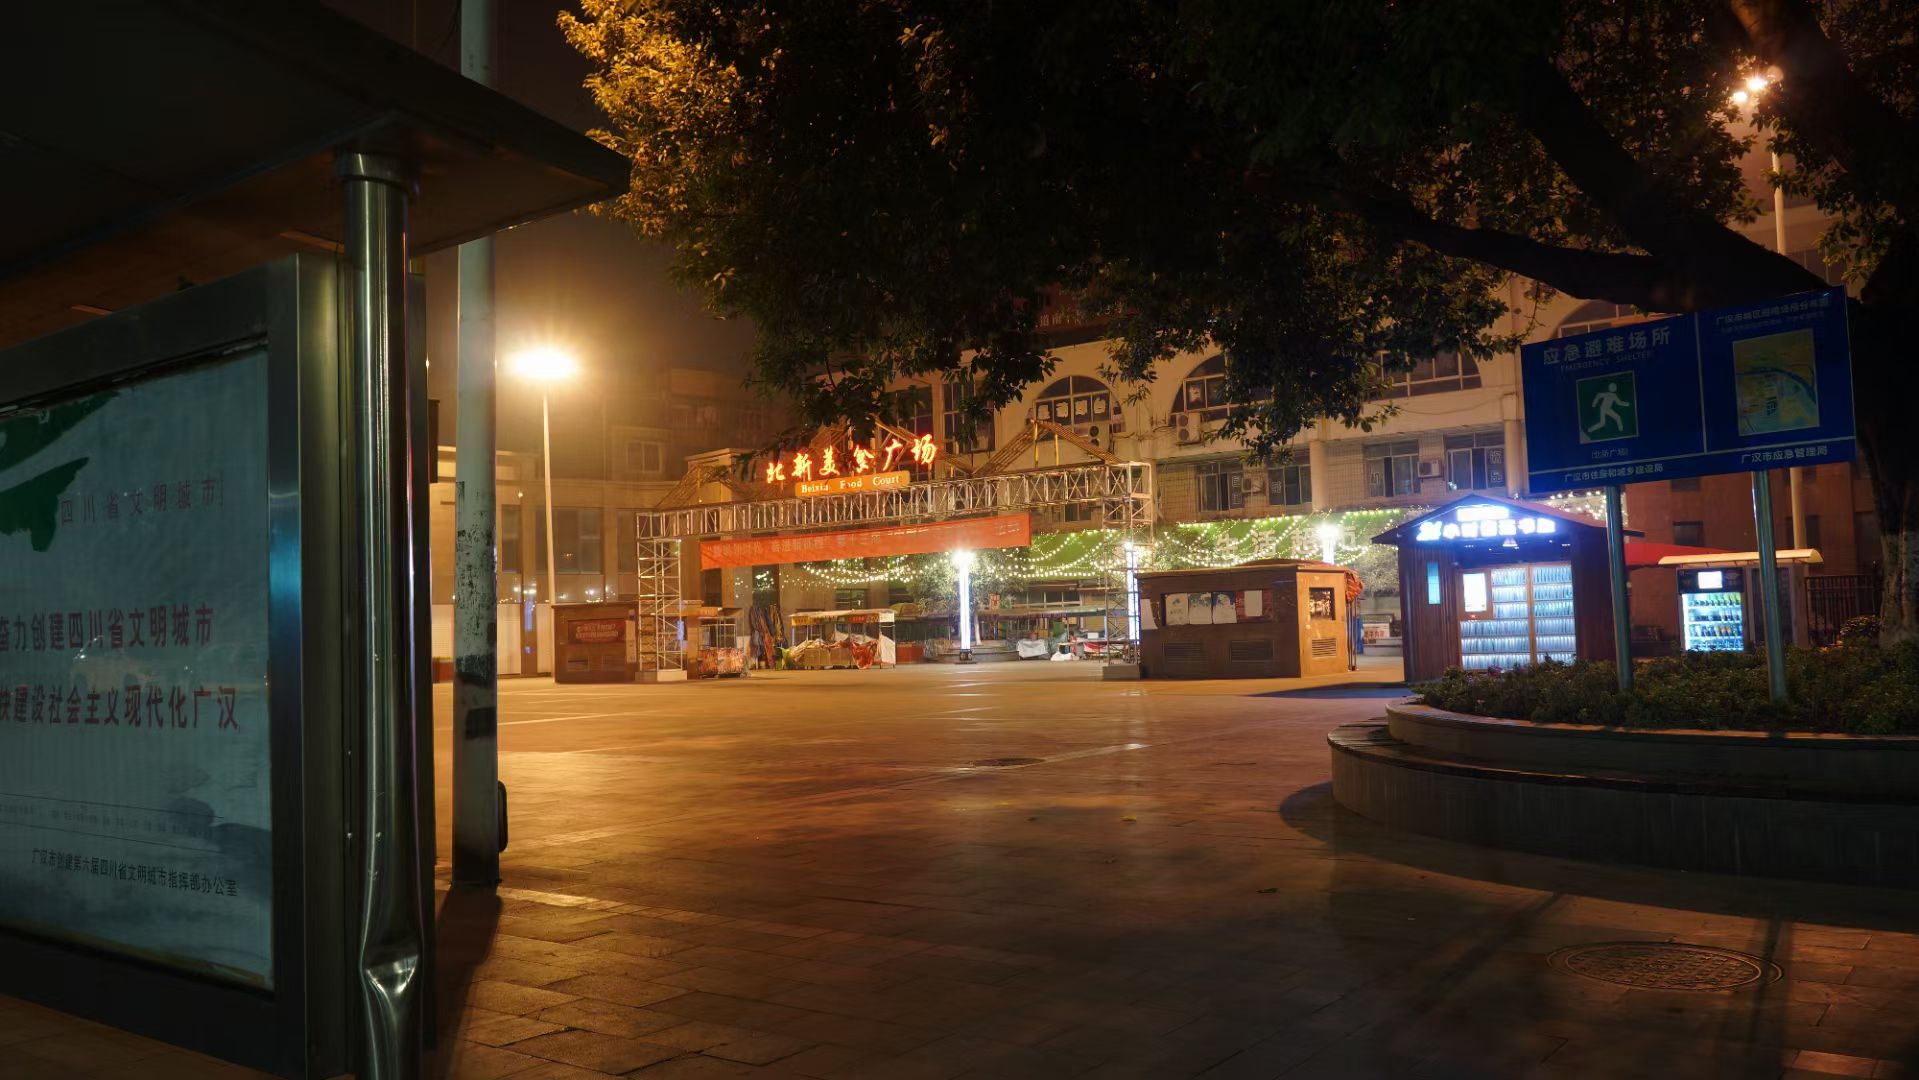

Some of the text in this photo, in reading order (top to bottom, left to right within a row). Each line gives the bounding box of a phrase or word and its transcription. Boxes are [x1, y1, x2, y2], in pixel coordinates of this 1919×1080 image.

[1543, 326, 1671, 365] 应急避难场所
[1560, 350, 1652, 372] EMERGENCY SHELTER
[766, 433, 937, 482] 北新美食广场
[1741, 445, 1828, 464] 广汉市应急管理局
[873, 475, 899, 486] Court
[1564, 463, 1664, 483] 广汉市住房和城乡建设局
[61, 479, 215, 523] 四川省文明城市
[31, 848, 238, 897] 广汉市创建第六届四川省文明城市指挥部办公室
